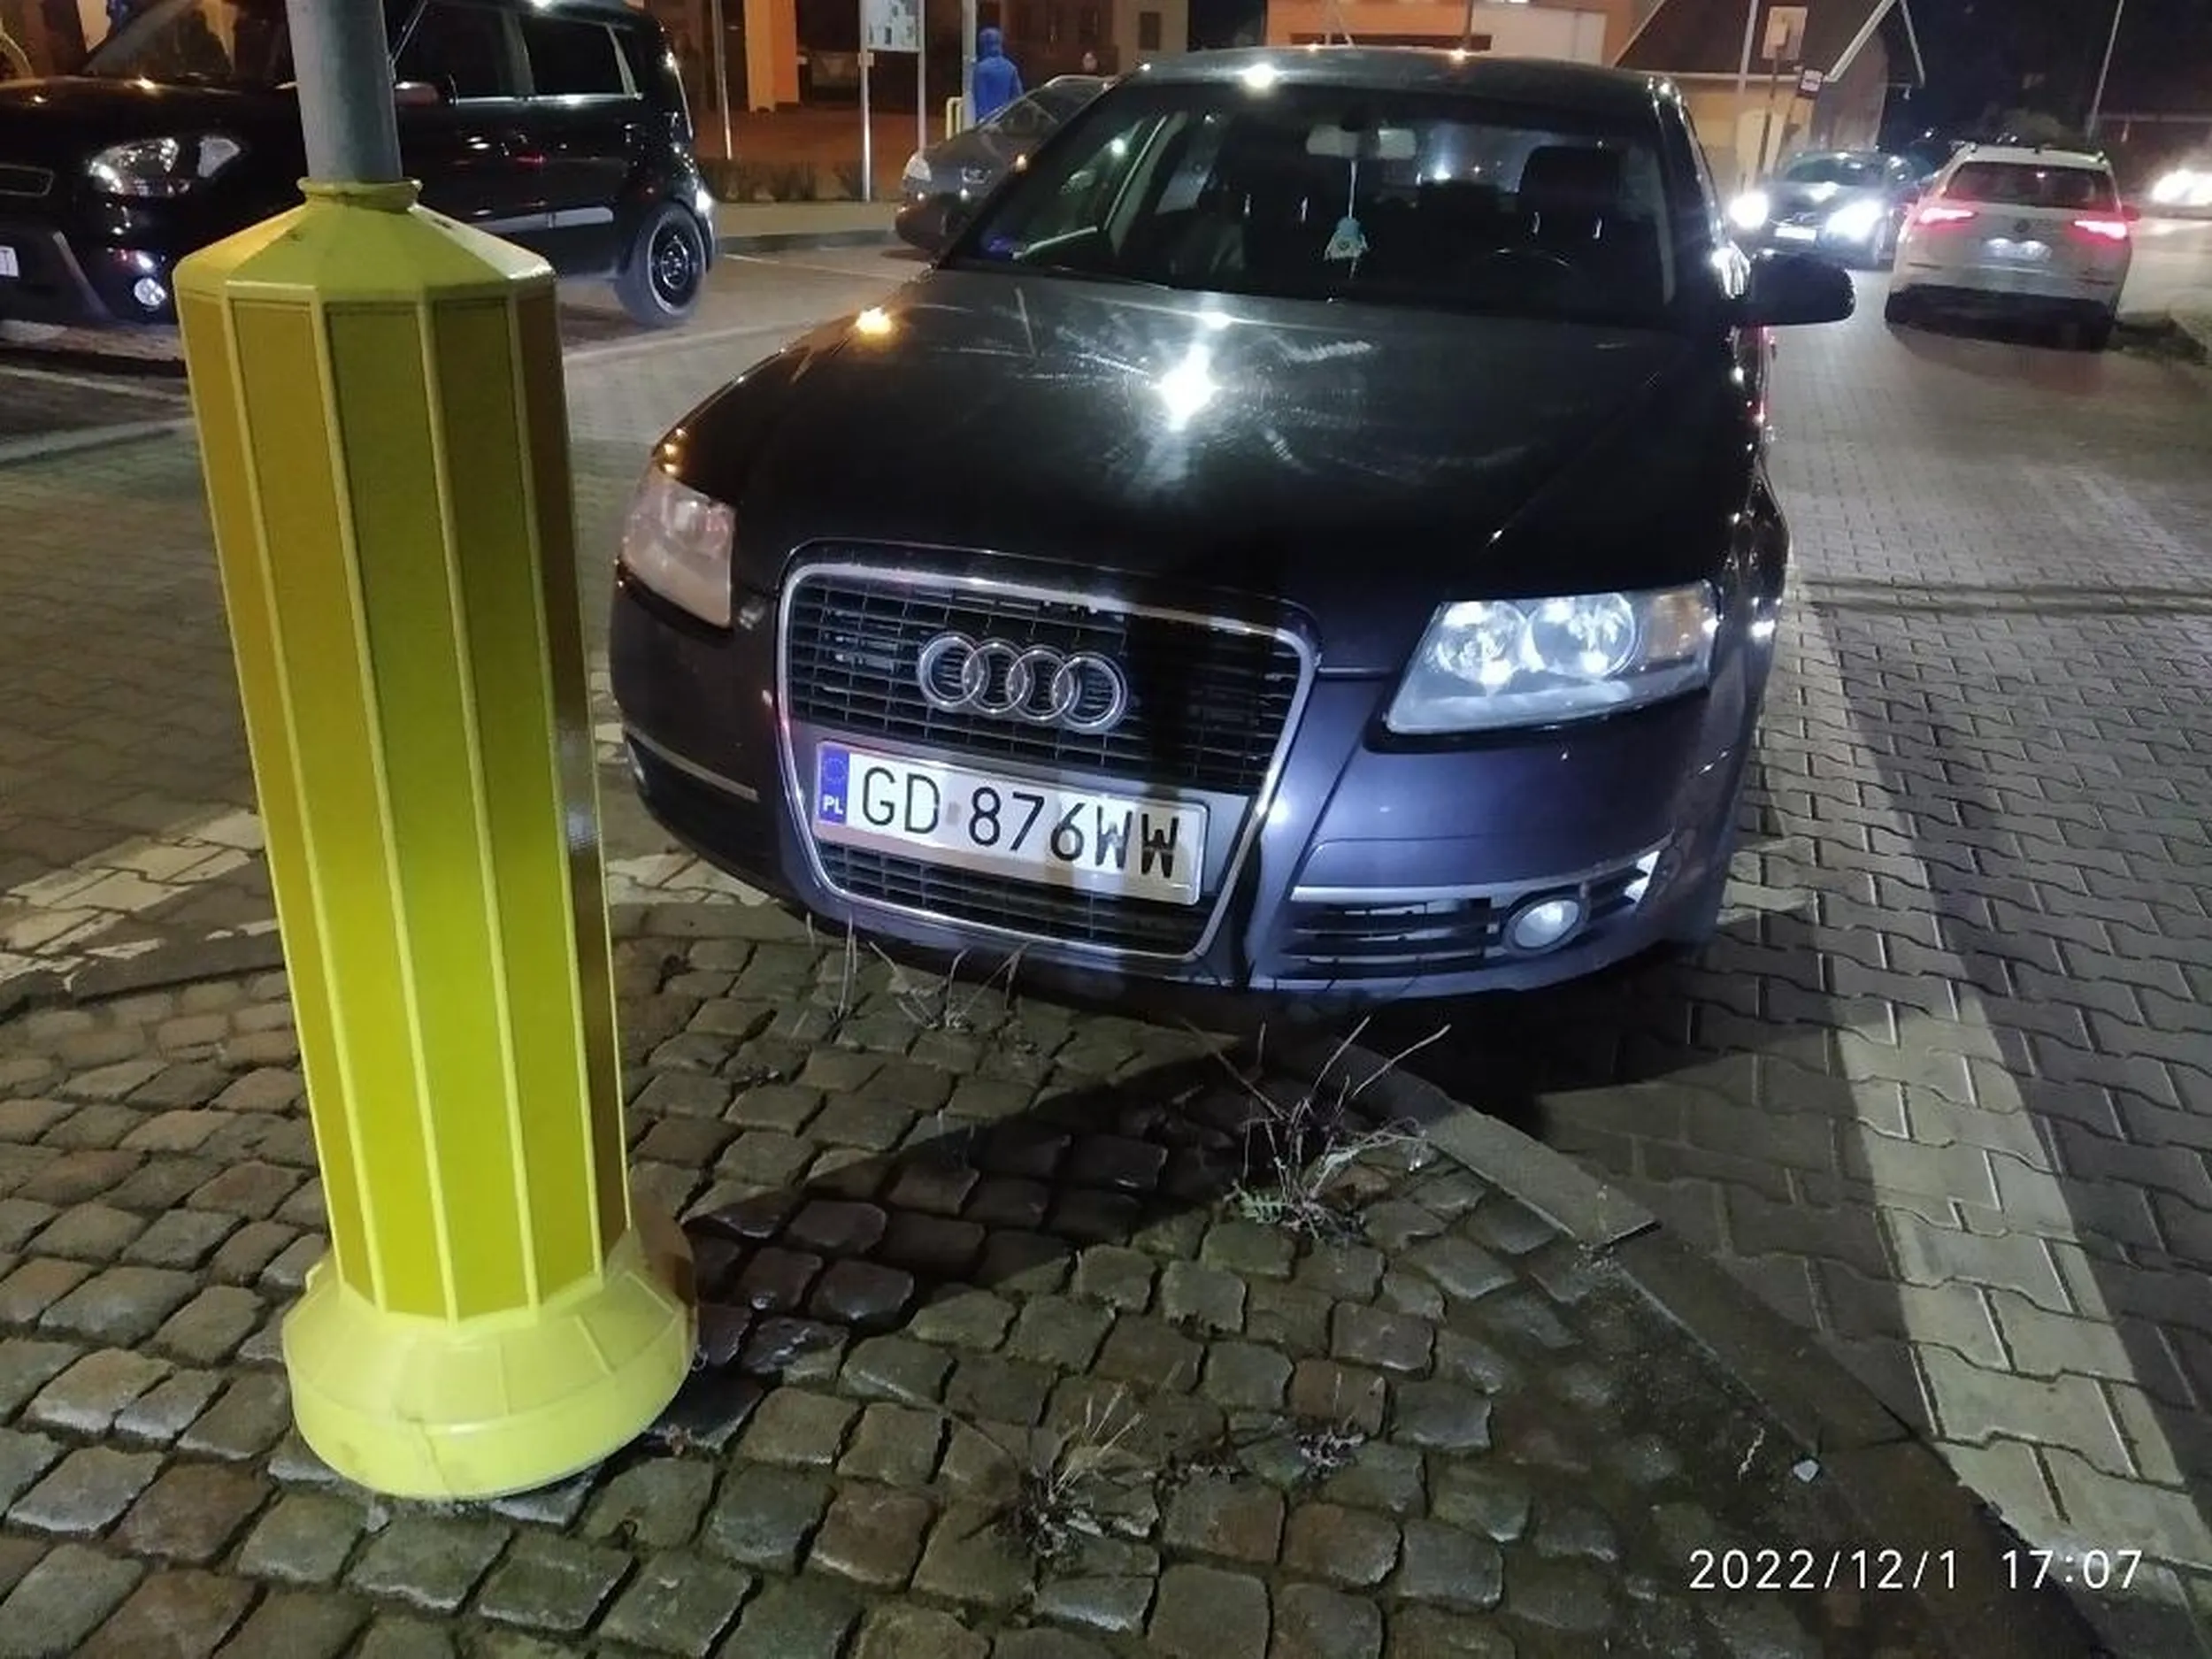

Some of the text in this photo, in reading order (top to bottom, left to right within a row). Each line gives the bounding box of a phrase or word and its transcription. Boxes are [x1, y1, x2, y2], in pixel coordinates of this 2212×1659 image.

[822, 795, 844, 816] PL
[862, 766, 1180, 879] GD 876WW
